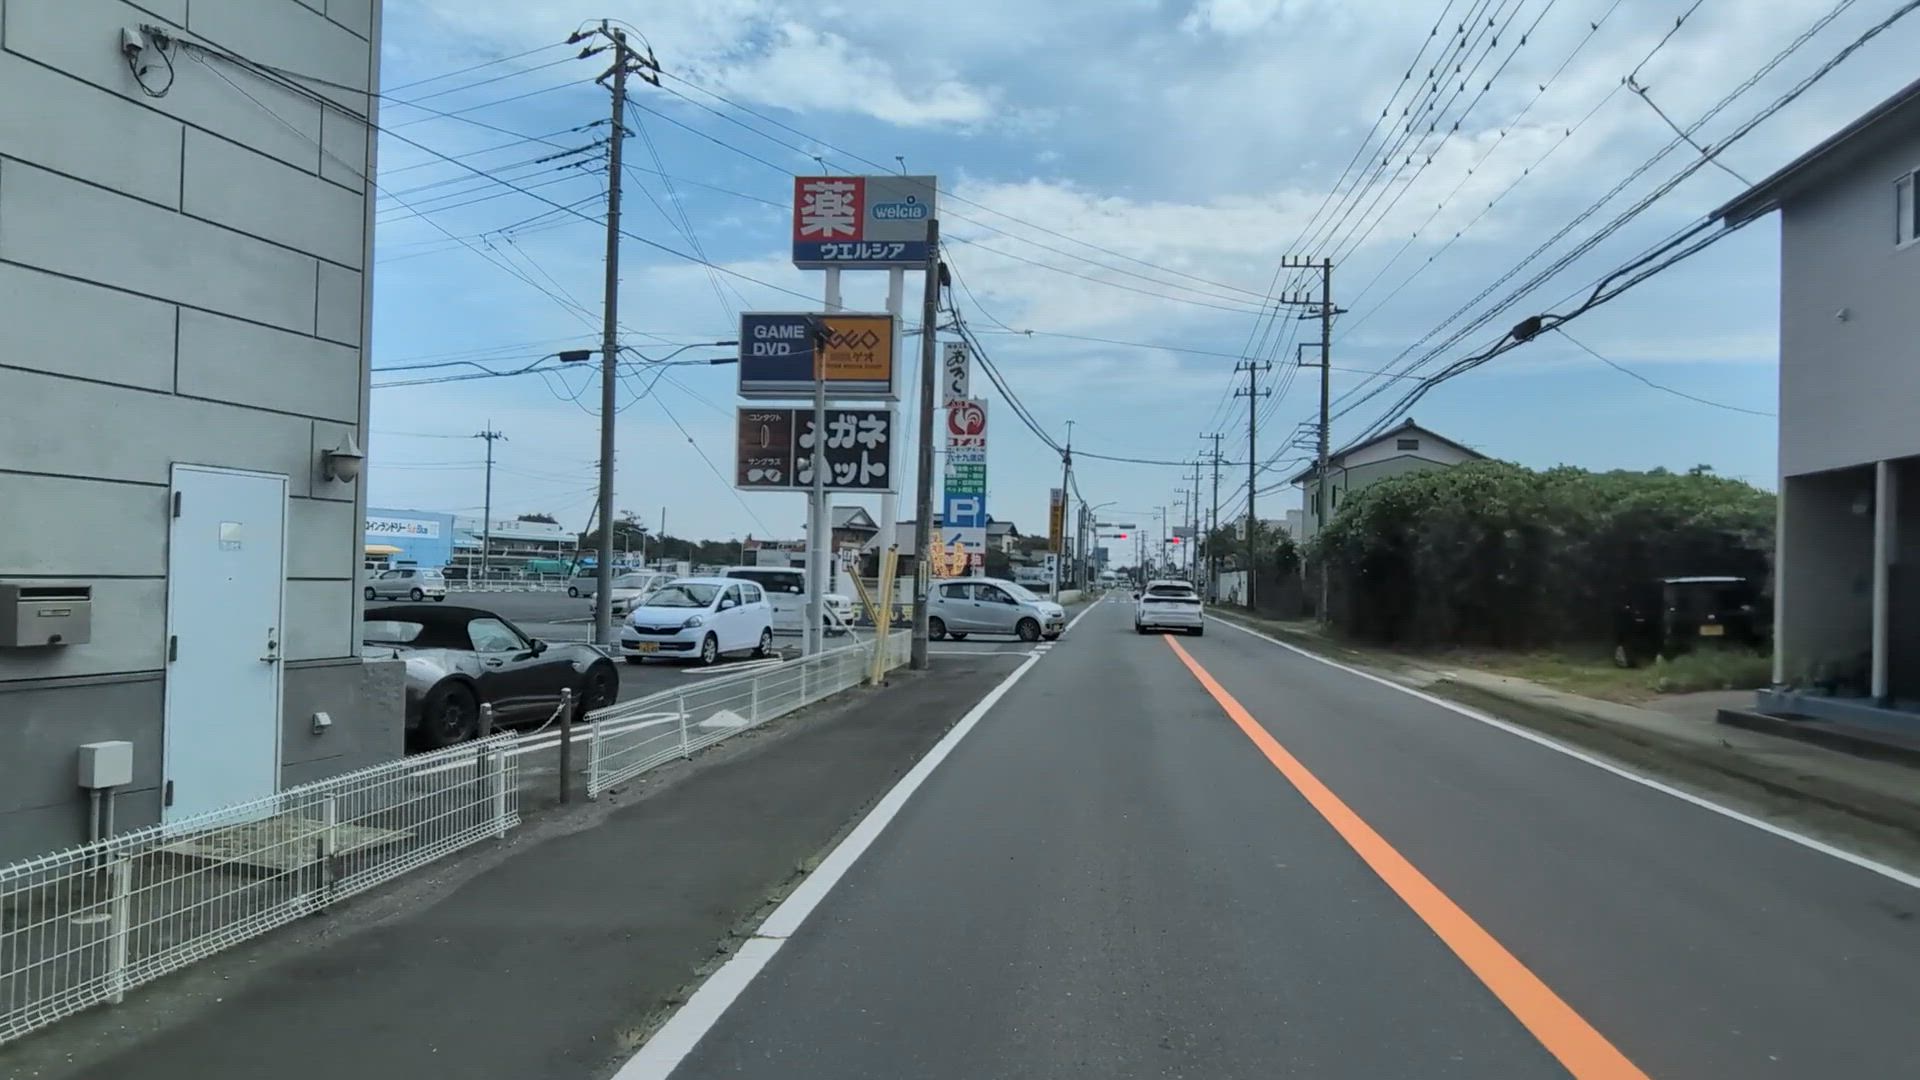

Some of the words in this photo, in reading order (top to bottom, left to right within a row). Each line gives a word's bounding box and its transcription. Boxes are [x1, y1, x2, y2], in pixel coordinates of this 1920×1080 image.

[800, 181, 856, 237] 薬
[875, 196, 922, 218] welcia
[820, 243, 905, 259] ウエルシア
[754, 325, 805, 339] GAME
[753, 342, 791, 355] DVD
[852, 351, 875, 363] ゲオ
[748, 413, 782, 422] コンタクト
[799, 413, 888, 449] メガネ
[947, 438, 986, 447] コメリ
[747, 458, 782, 466] サングラス
[949, 498, 979, 523] P
